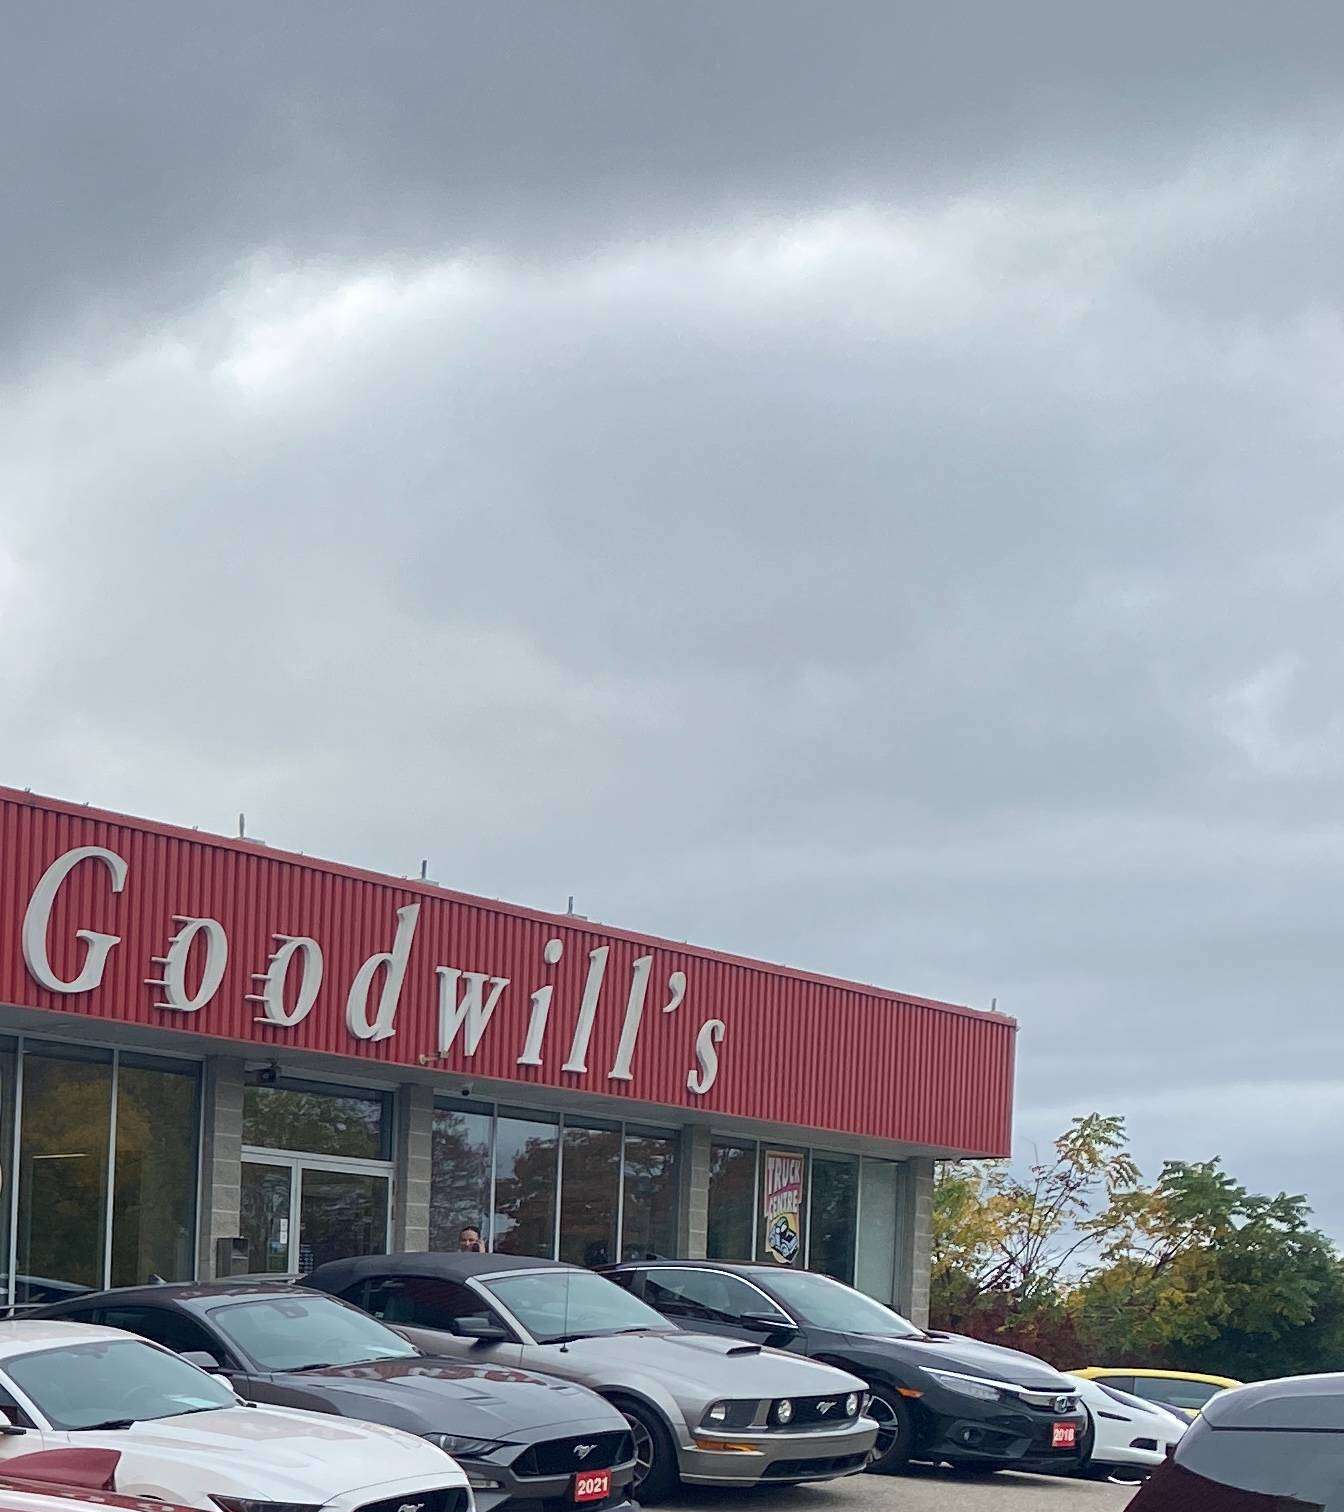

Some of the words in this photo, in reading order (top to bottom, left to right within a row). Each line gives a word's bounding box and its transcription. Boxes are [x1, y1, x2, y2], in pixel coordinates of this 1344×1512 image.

[22, 845, 726, 1095] Goodwill's
[767, 1157, 801, 1195] TRUCK
[767, 1188, 799, 1220] CENTRE
[577, 1476, 609, 1496] 2021
